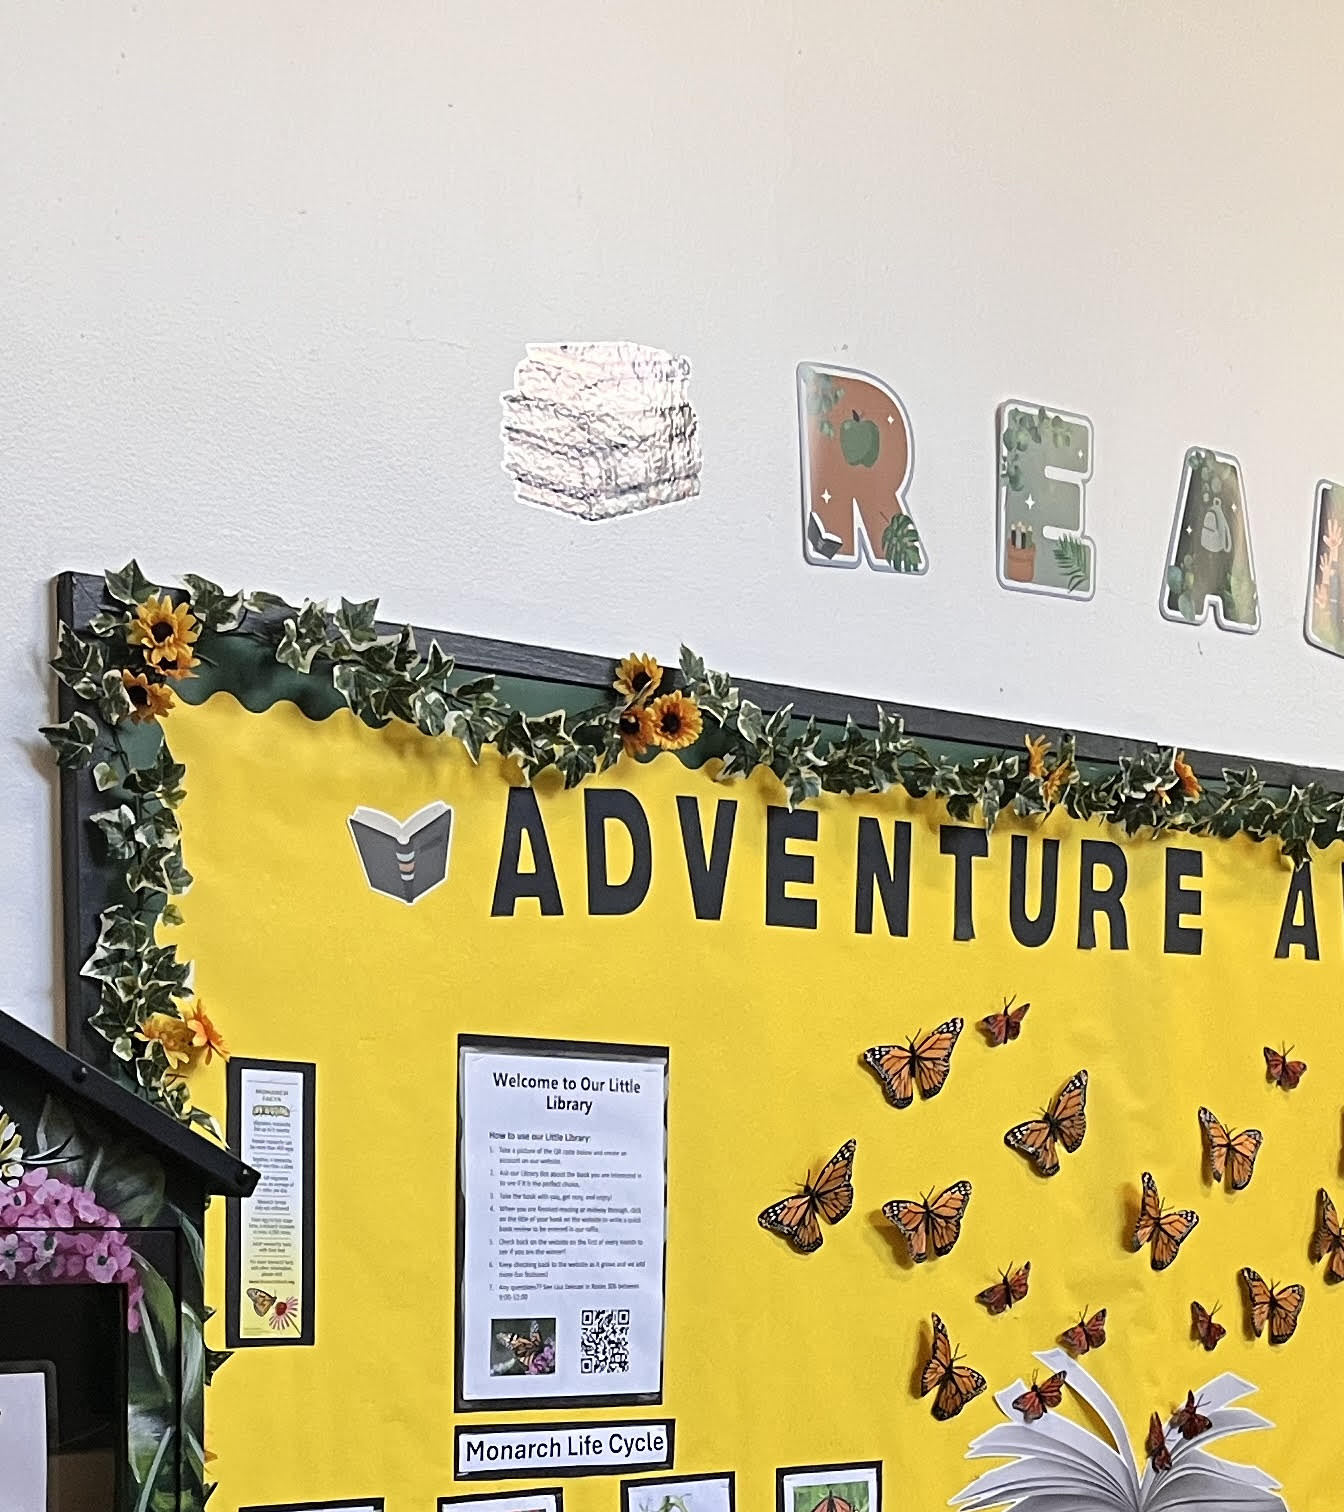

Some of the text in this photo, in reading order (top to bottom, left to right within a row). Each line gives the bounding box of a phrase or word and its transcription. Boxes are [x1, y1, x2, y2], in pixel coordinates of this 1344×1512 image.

[491, 786, 1204, 956] ADVENTURE
[493, 1072, 641, 1094] Welcome to Our Little
[546, 1096, 593, 1116] Library
[489, 1131, 506, 1140] How
[508, 1132, 516, 1141] to
[545, 1133, 564, 1142] Little
[465, 1431, 664, 1462] Monarch Life Cycle
